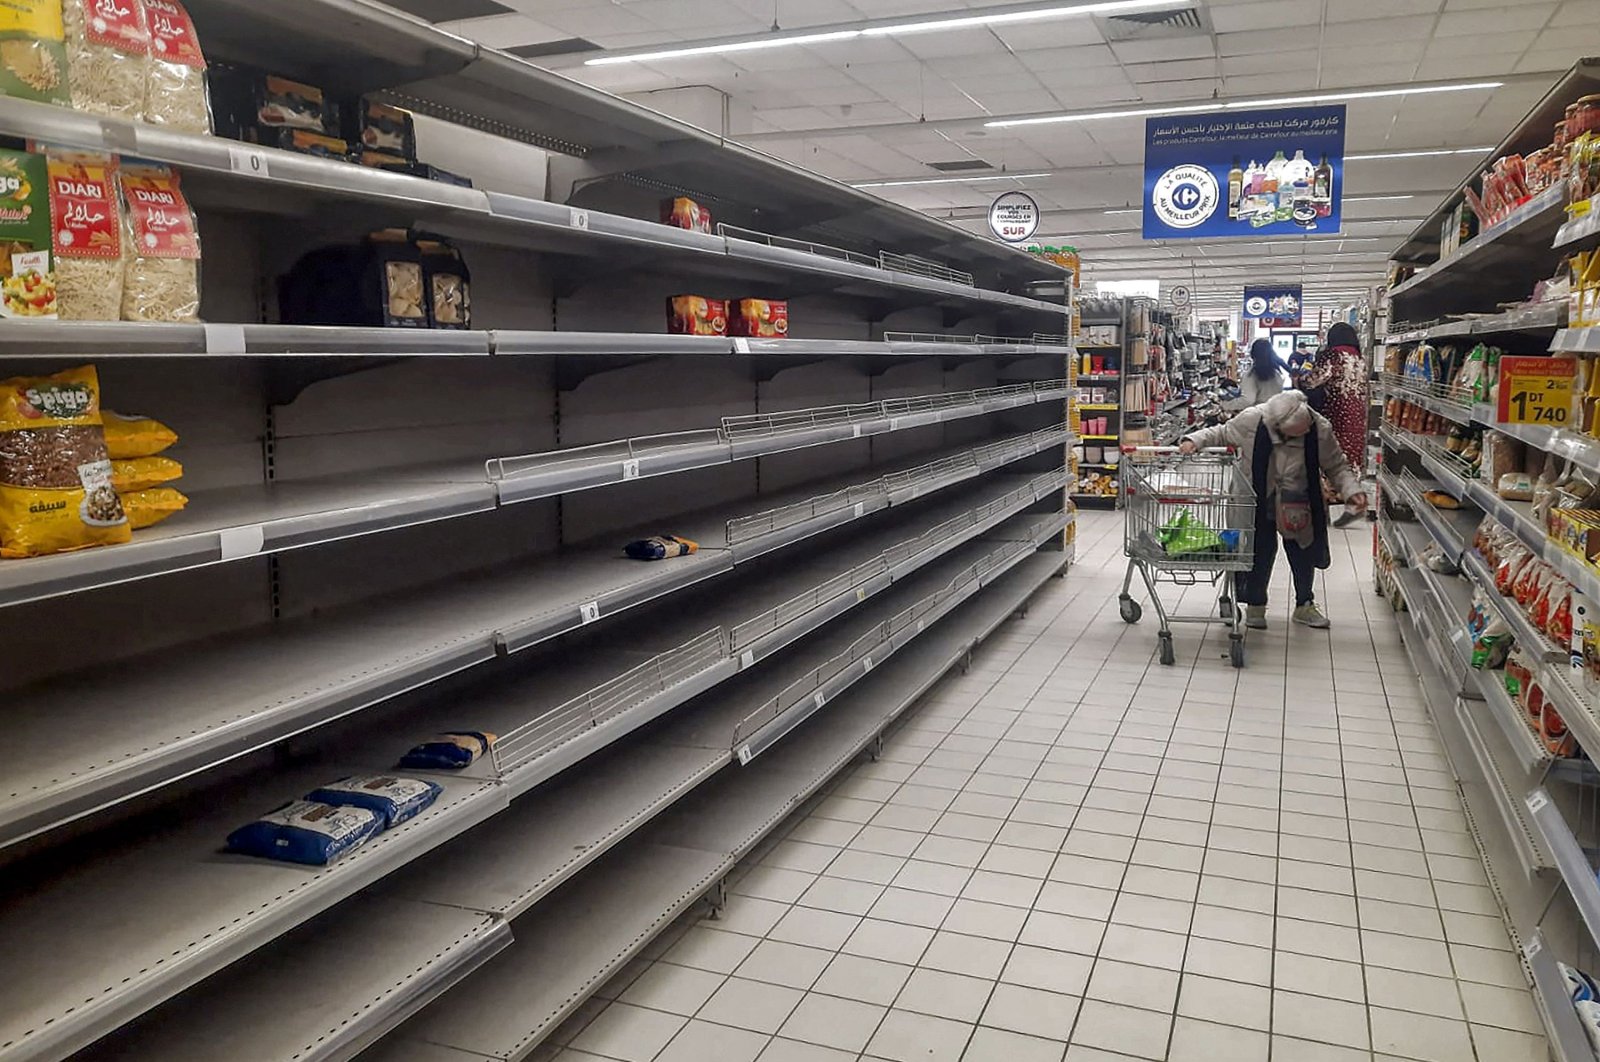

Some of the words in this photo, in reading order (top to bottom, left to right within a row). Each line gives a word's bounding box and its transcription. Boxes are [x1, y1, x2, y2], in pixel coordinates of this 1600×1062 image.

[1310, 115, 1339, 128] كارفور
[251, 155, 260, 171] 0
[58, 180, 102, 199] DIARI
[1164, 179, 1174, 190] LA
[135, 190, 175, 205] DIARI
[1160, 197, 1168, 208] AU
[1164, 207, 1200, 220] MEILLEUR
[1198, 194, 1211, 212] PRIX
[578, 215, 585, 226] 0
[1003, 226, 1025, 235] SUR
[25, 386, 89, 411] Spiga
[1511, 391, 1528, 421] 1
[1529, 392, 1545, 403] DT
[1533, 406, 1567, 422] 740
[589, 606, 595, 618] 0
